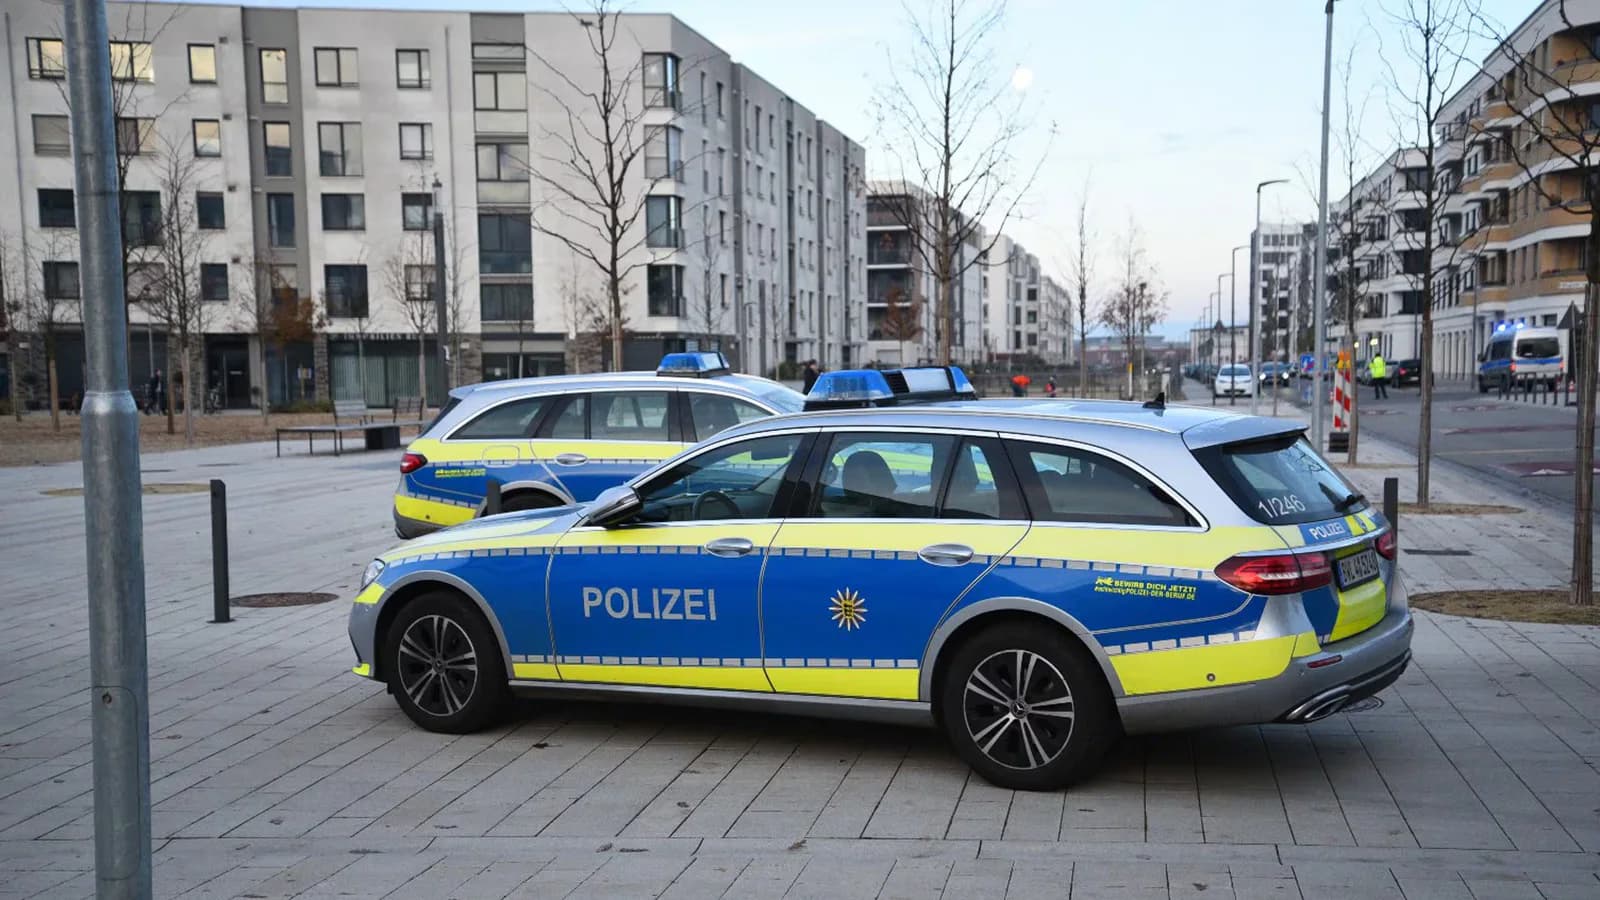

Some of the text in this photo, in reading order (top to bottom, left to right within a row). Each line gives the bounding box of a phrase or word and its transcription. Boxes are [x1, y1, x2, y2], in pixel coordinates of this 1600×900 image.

[1258, 494, 1306, 519] 1/246
[1309, 522, 1346, 540] POLIZEI
[1114, 580, 1197, 593] BEWIRB DICH JETZT!
[582, 586, 717, 621] POLIZEI
